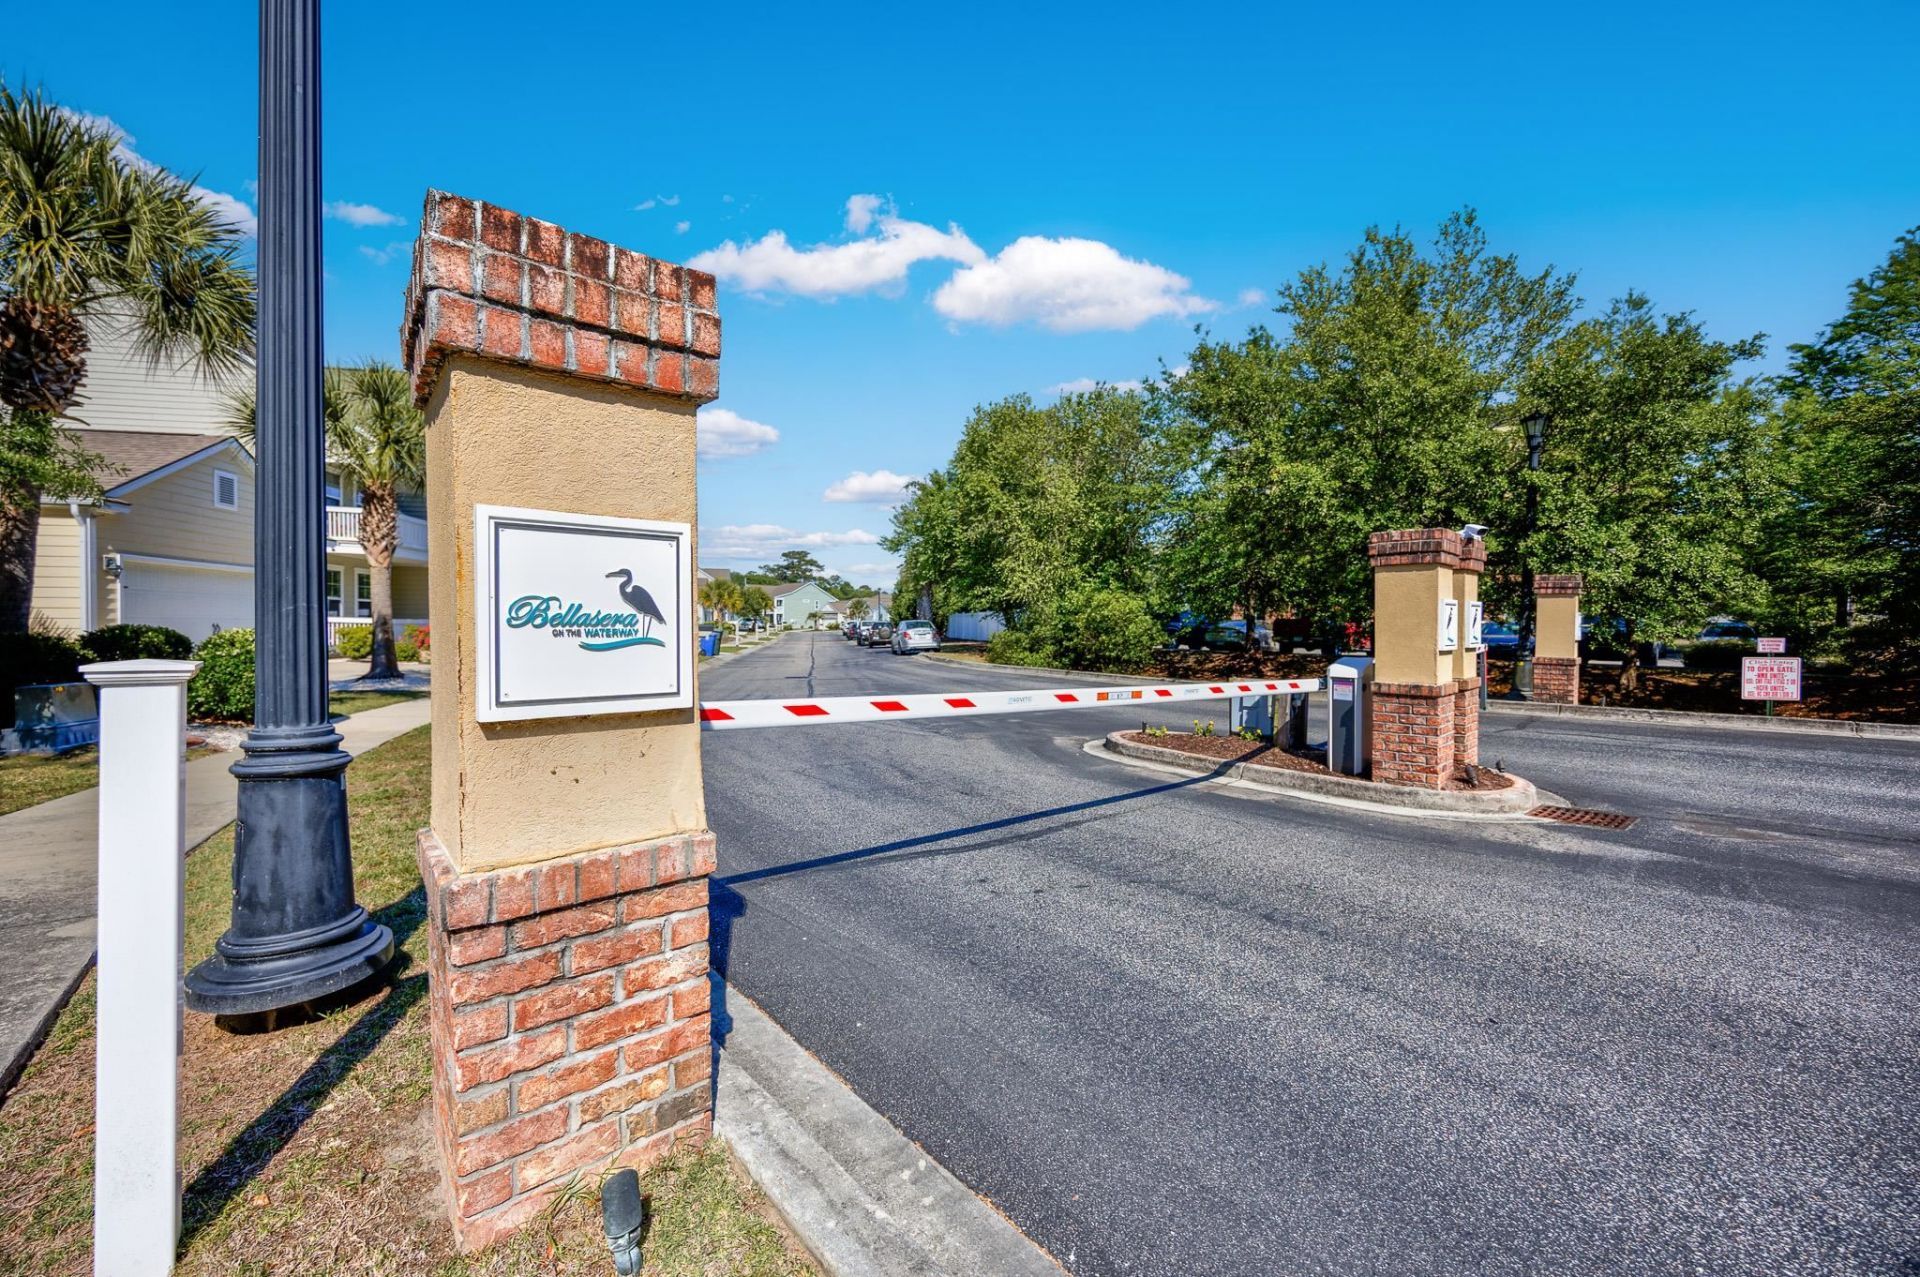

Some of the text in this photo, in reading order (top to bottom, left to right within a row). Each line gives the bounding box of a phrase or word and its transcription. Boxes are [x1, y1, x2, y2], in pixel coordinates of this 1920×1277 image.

[506, 595, 640, 629] Bellasera
[552, 628, 639, 638] ON THE WATERWAY
